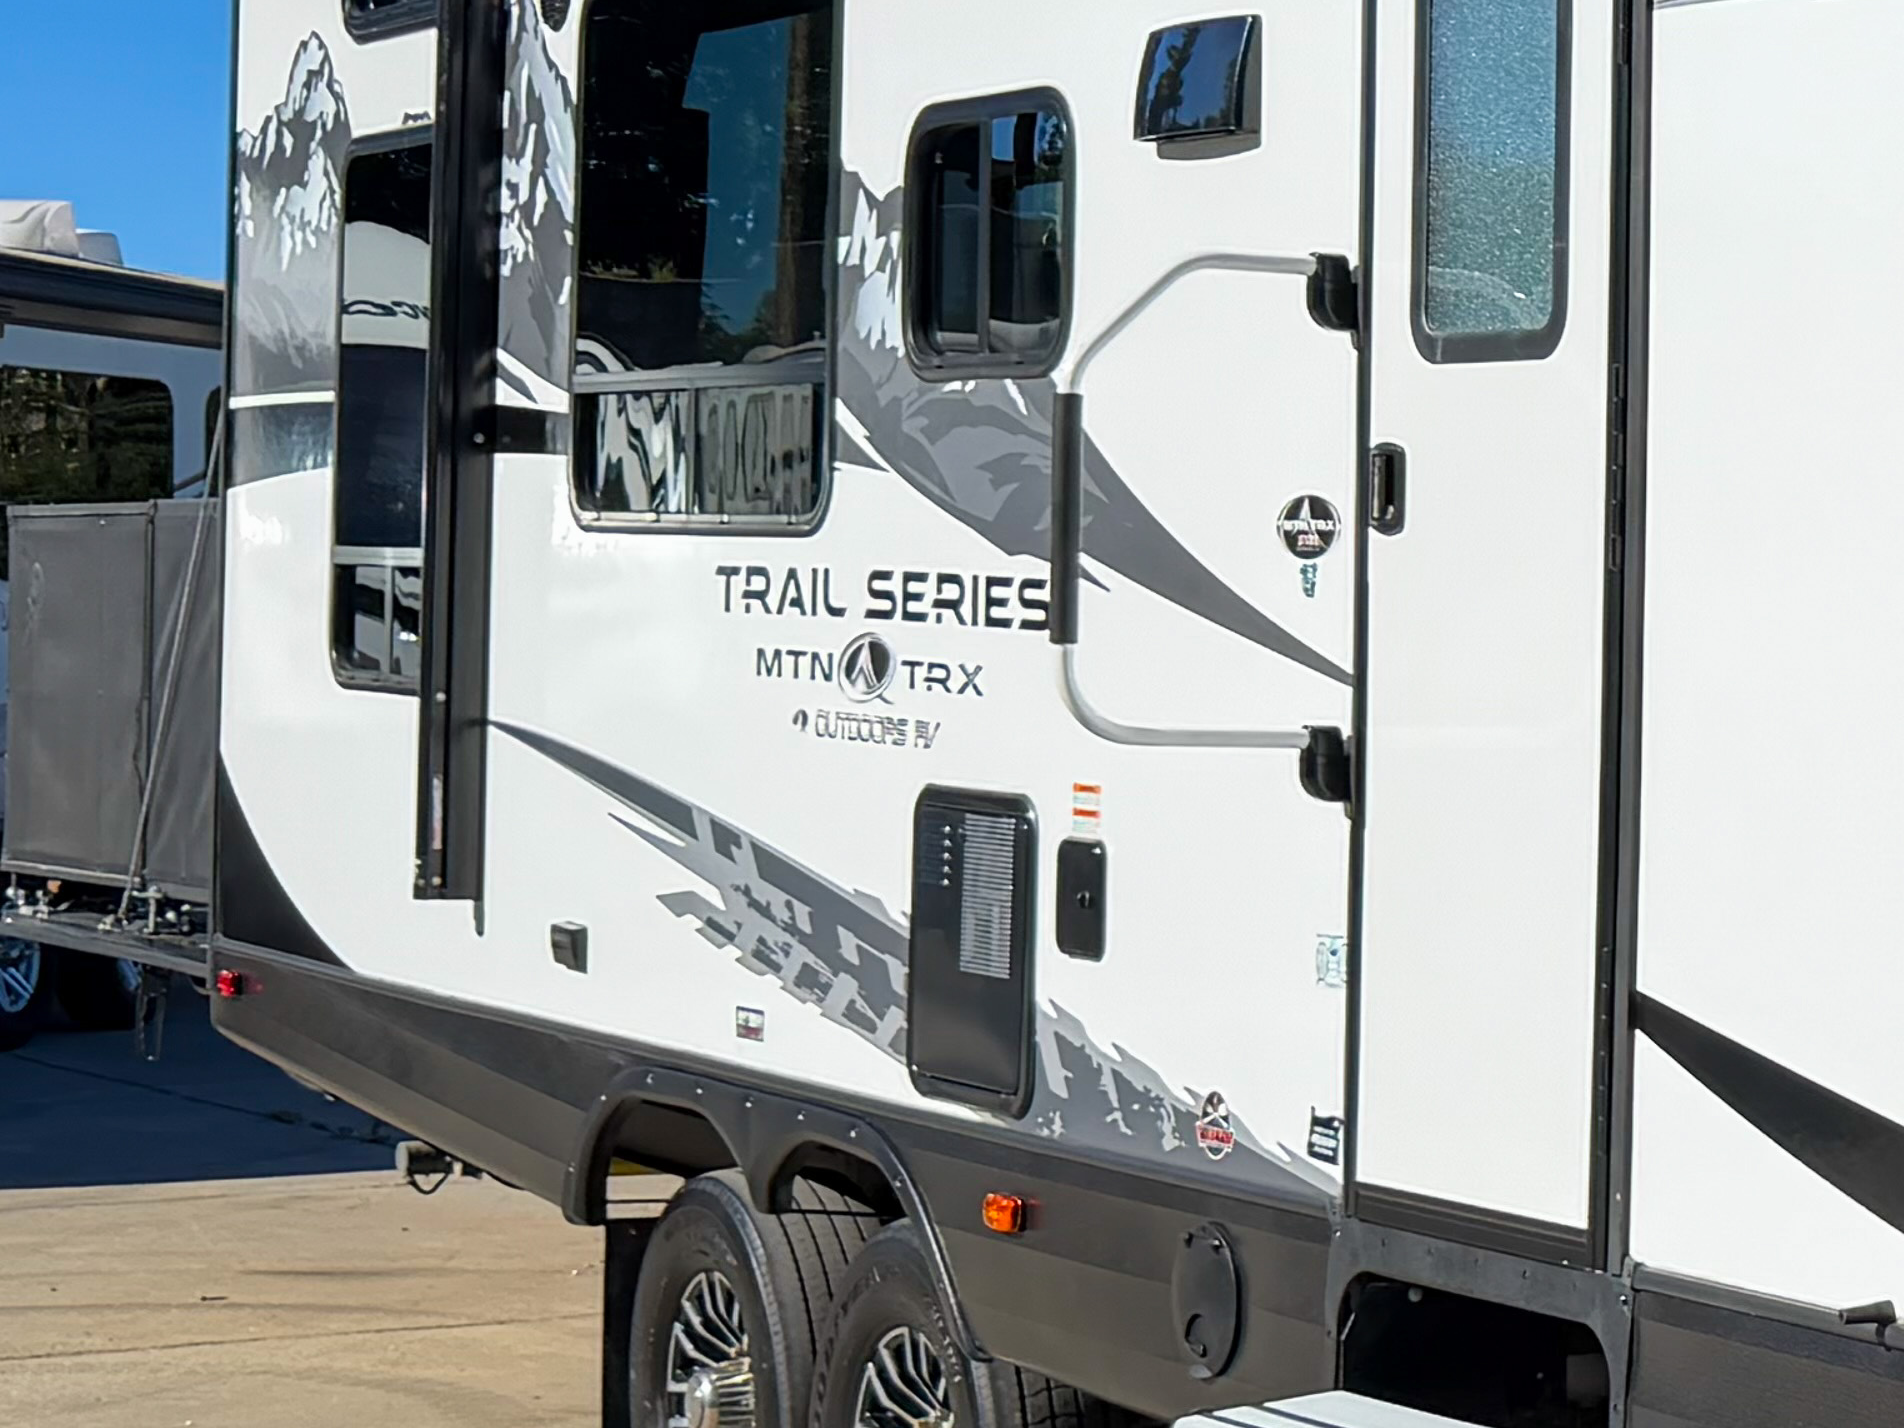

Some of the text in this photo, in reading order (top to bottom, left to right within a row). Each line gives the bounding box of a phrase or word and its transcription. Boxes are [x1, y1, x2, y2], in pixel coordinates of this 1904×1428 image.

[715, 566, 1052, 631] TRAIL SERIES
[756, 648, 984, 697] MTN TRX
